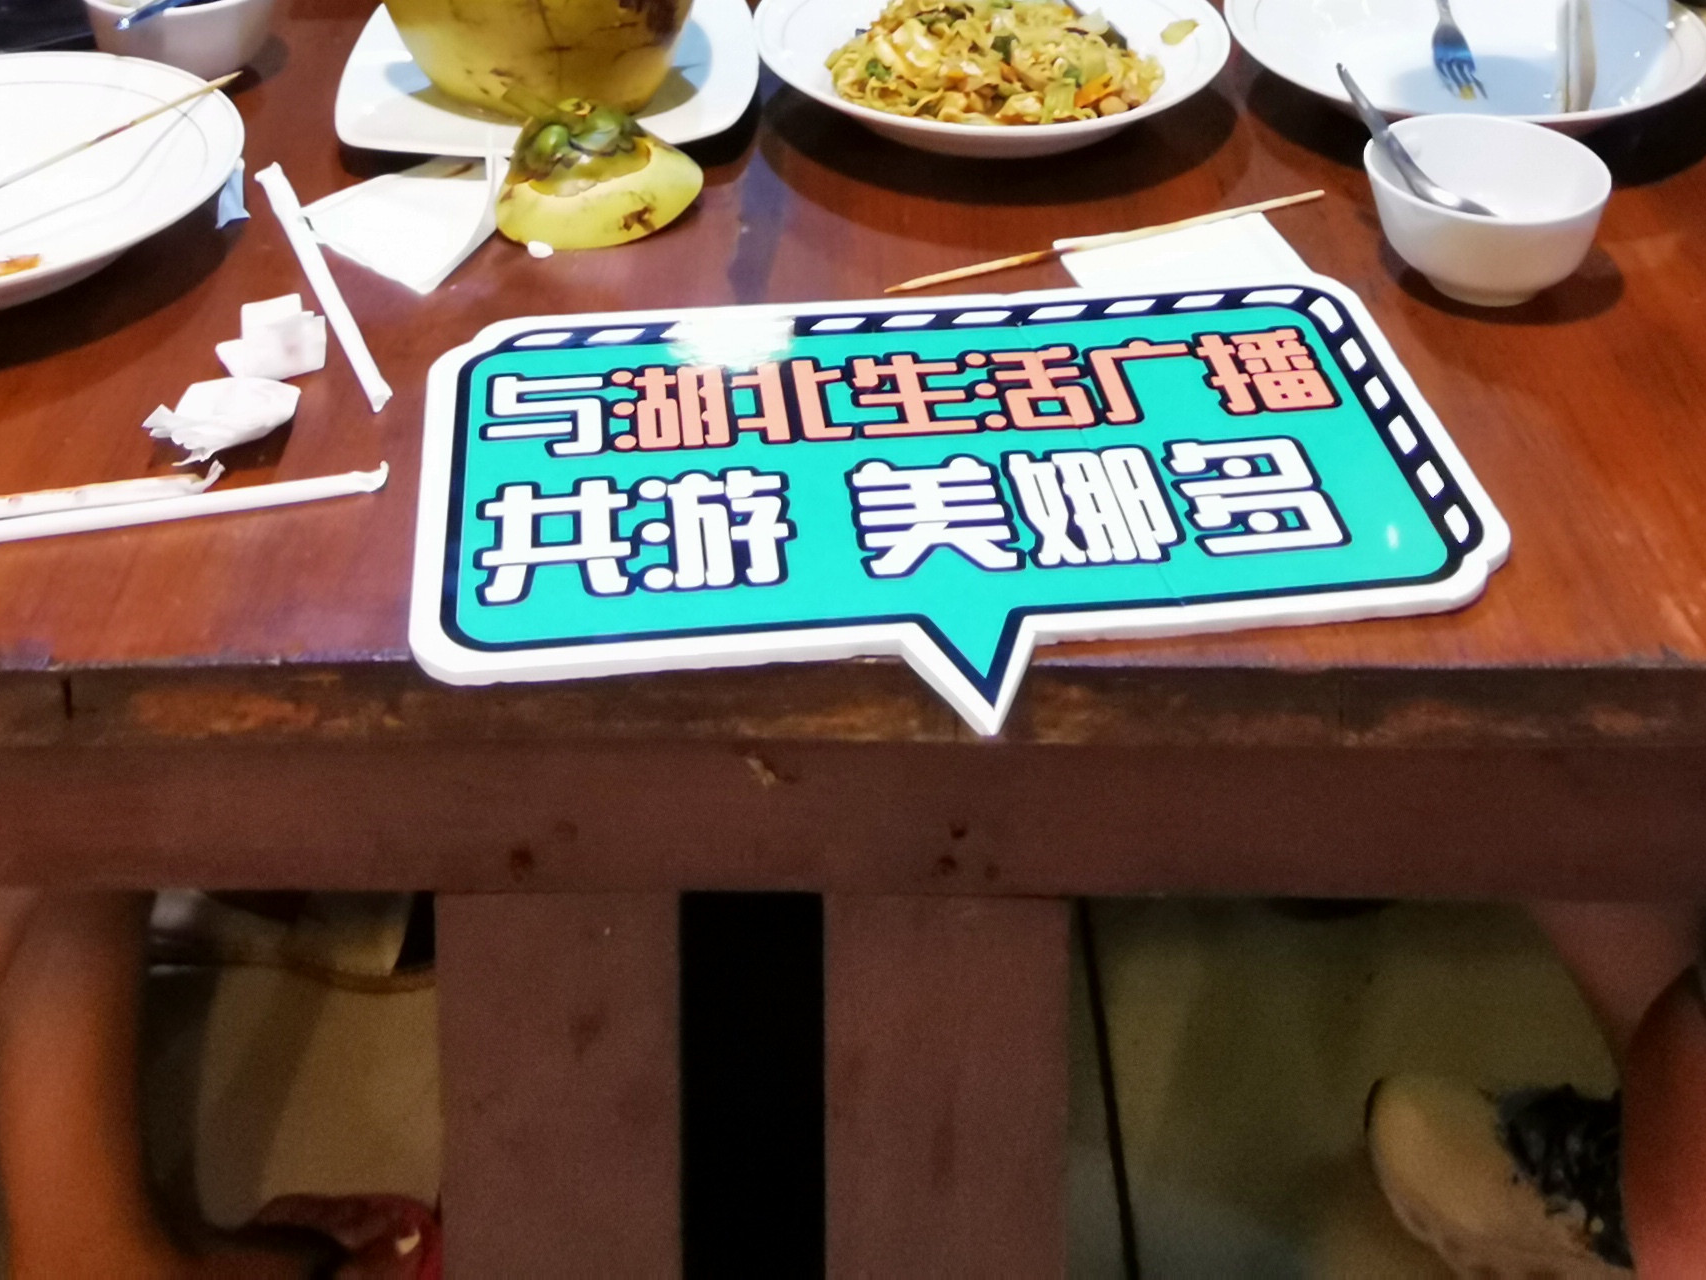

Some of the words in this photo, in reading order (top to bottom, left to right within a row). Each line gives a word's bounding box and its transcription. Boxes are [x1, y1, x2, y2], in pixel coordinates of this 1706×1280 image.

[485, 327, 1343, 457] 与湖北生活广播
[477, 468, 794, 604] 共游
[848, 436, 1350, 580] 美娜多
